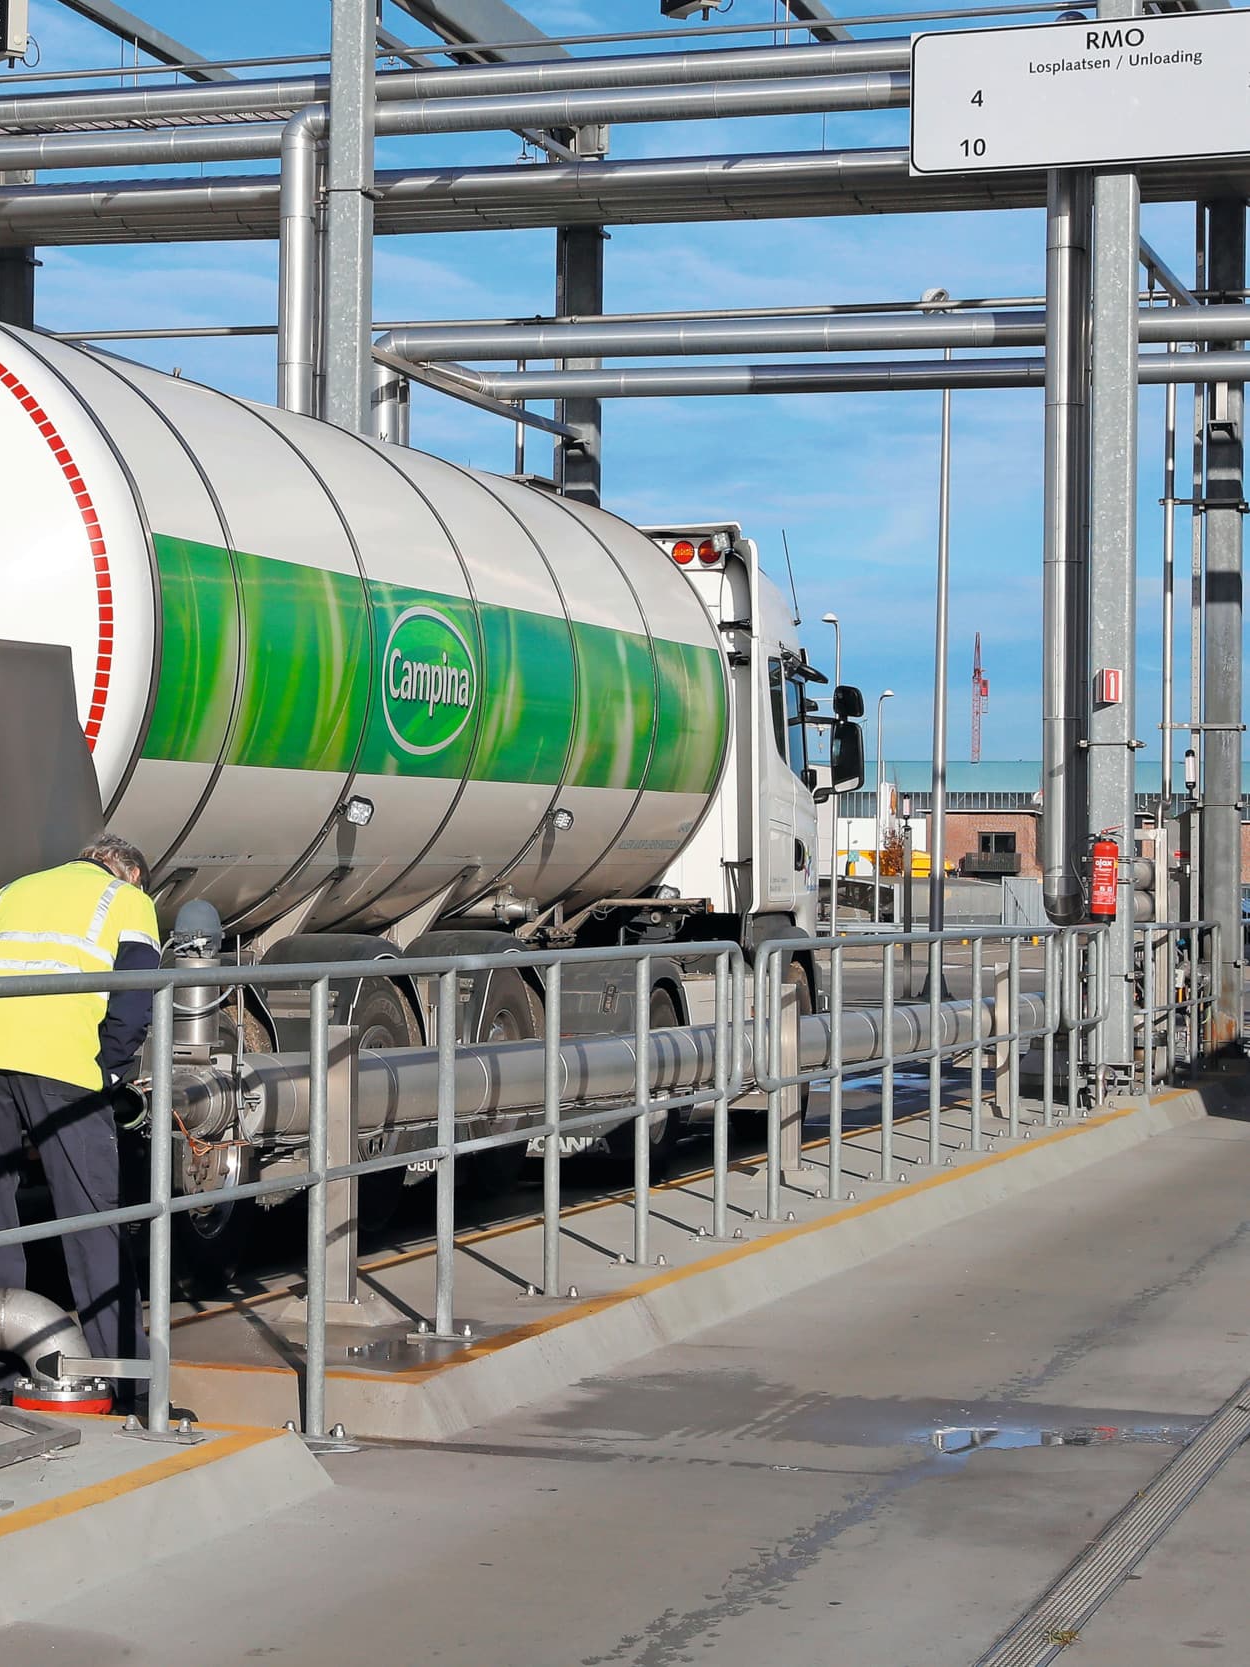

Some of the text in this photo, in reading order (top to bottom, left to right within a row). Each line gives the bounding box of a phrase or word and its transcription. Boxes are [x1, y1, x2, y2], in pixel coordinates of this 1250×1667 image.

[1085, 27, 1146, 51] RMO
[1028, 49, 1203, 76] Losplaatsen / Unloading
[969, 89, 985, 108] 4
[959, 138, 988, 158] 10
[389, 647, 470, 717] Campina
